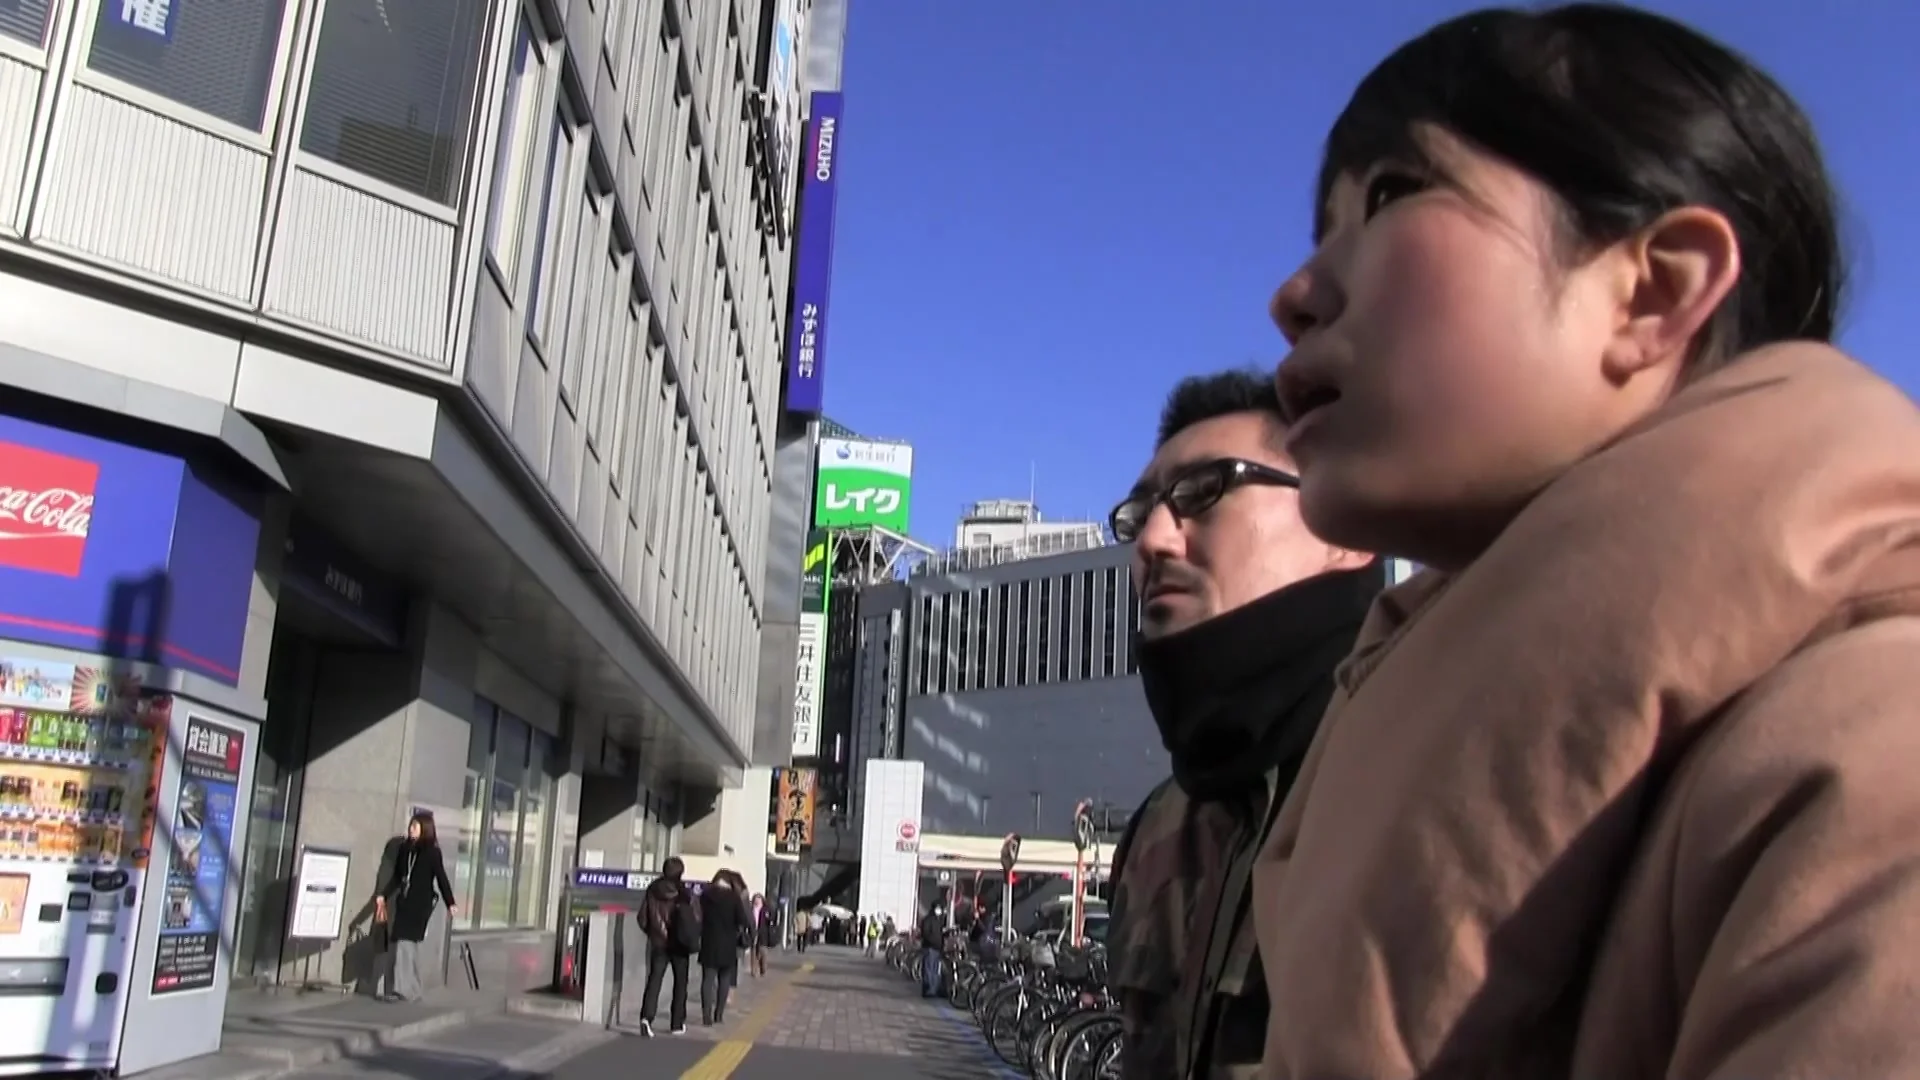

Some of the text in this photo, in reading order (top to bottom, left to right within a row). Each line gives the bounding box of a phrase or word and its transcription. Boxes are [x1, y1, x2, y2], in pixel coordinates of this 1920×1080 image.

[816, 115, 836, 181] MIZUHO
[825, 483, 901, 515] レイク
[793, 622, 817, 744] 三井住友銀行
